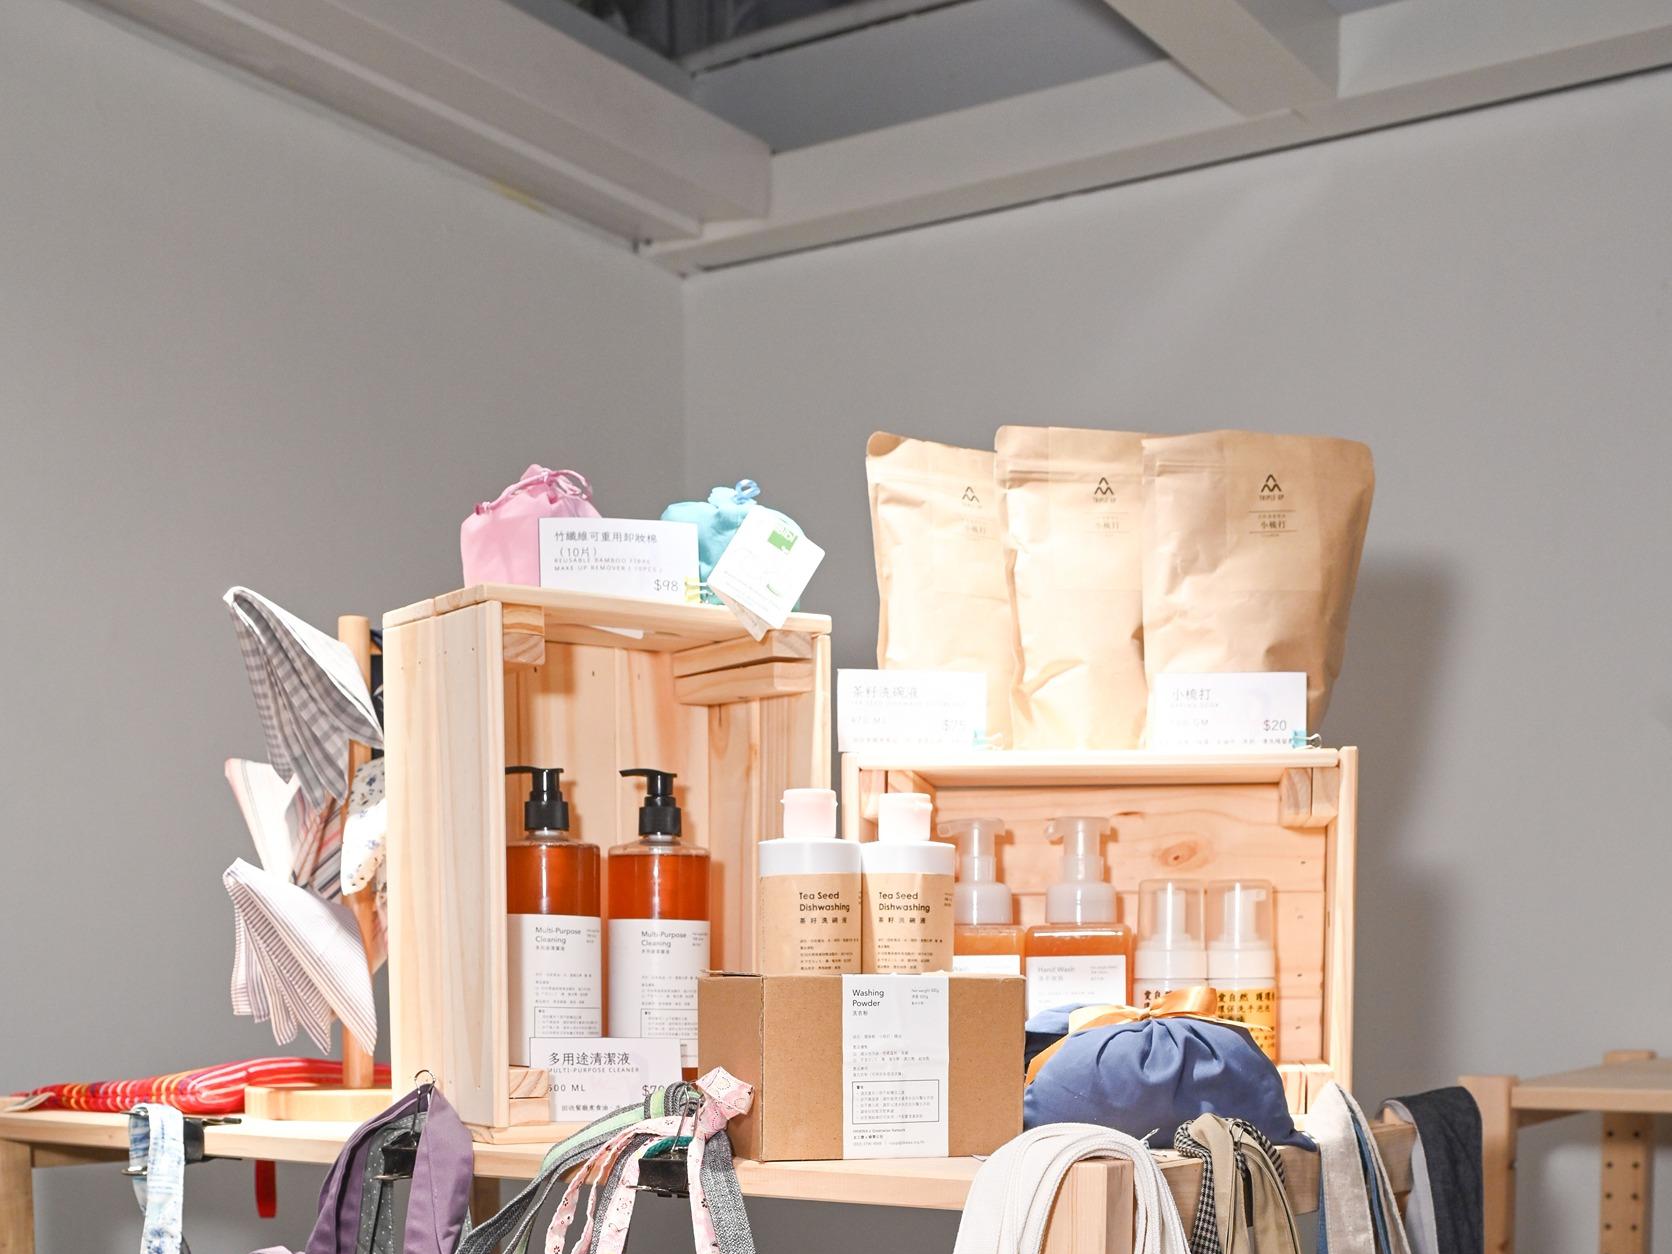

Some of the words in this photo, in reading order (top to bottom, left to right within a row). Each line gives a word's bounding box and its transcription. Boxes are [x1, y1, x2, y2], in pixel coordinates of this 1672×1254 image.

[654, 579, 680, 592] $98
[1172, 688, 1212, 701] 小梳打
[1263, 719, 1287, 731] $20
[799, 892, 815, 900] Tea
[817, 891, 840, 900] Seed
[878, 892, 894, 900] Tea
[896, 891, 919, 900] Seed
[799, 903, 850, 913] Dishwashing
[878, 903, 931, 913] Dishwashing
[535, 927, 582, 936] Multi-Purpose
[641, 930, 687, 939] Multi-Purpose
[535, 935, 567, 944] Cleaning
[641, 939, 672, 948] Cleaning
[852, 989, 885, 999] Washing
[852, 999, 881, 1007] Powder
[548, 1052, 631, 1066] 多用途清潔液
[571, 1084, 586, 1092] ML
